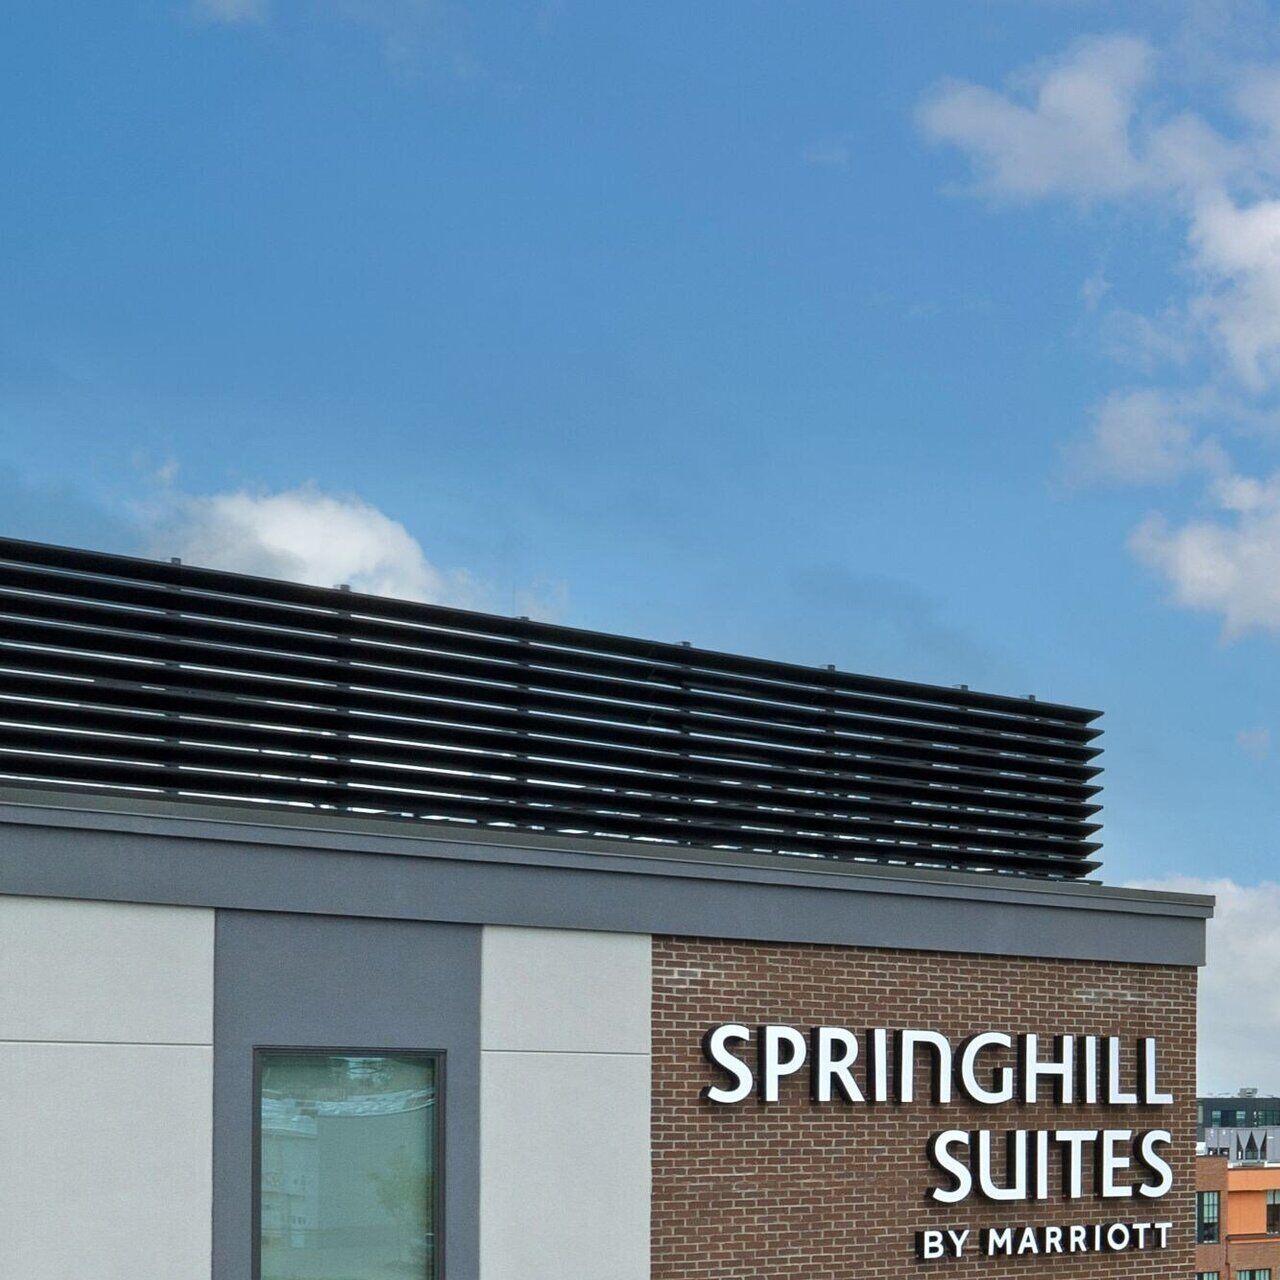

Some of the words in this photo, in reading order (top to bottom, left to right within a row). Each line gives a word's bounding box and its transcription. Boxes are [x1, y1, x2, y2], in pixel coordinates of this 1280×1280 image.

[703, 1023, 1174, 1105] SPRINGHILL
[930, 1129, 1174, 1204] SUITES
[921, 1229, 970, 1260] BY
[986, 1221, 1173, 1256] MARRIOTT
